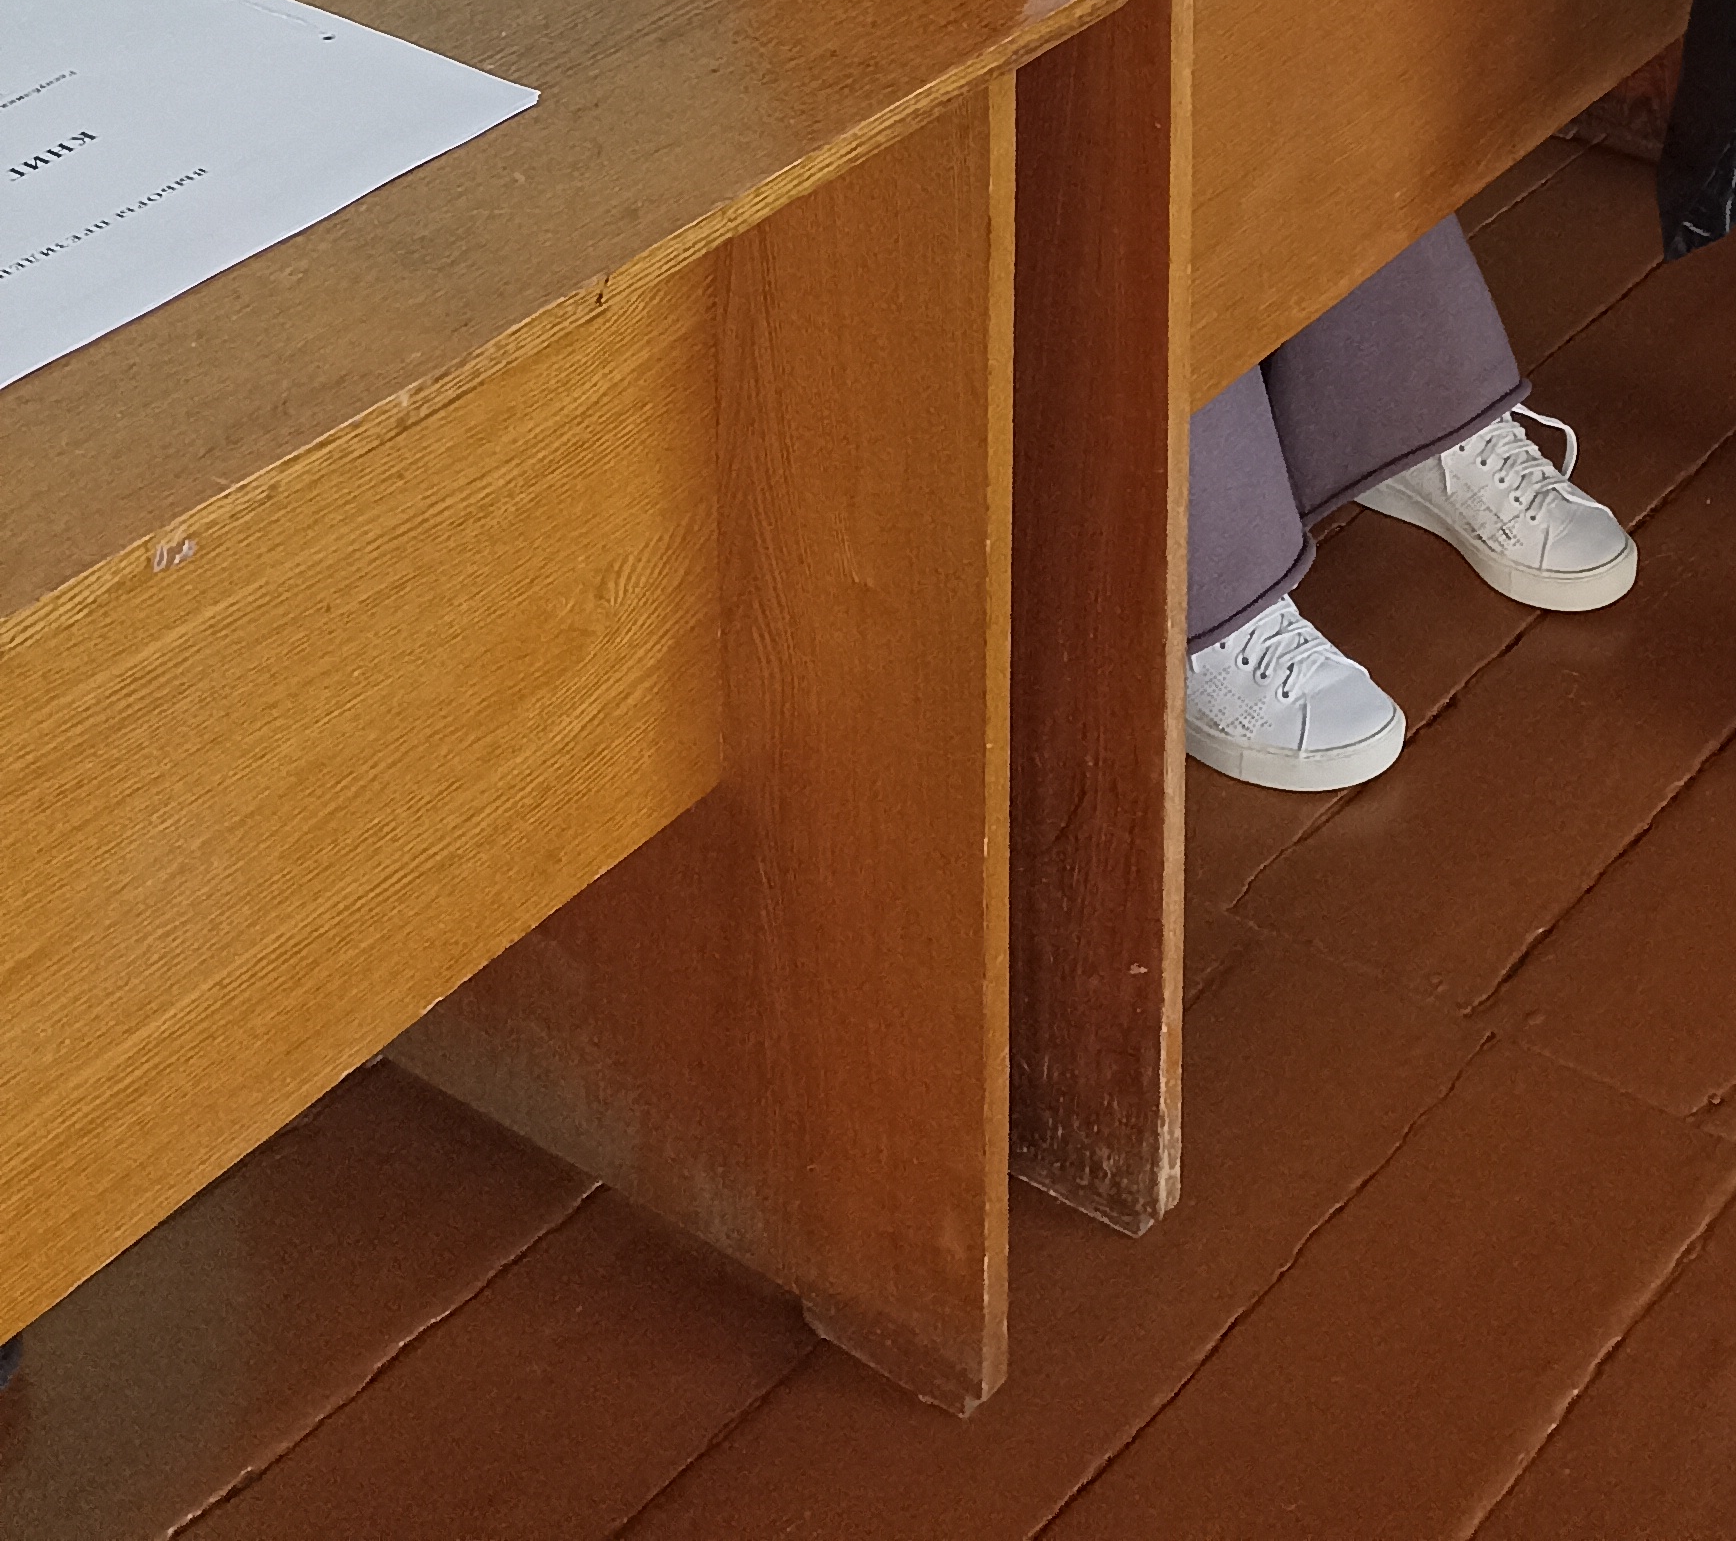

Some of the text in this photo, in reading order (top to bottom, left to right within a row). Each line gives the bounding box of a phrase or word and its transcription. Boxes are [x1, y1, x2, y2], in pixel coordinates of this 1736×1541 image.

[8, 130, 99, 182] КНИГ
[0, 167, 208, 279] ВЫБОРЫ ПРЕЗИДЕН
